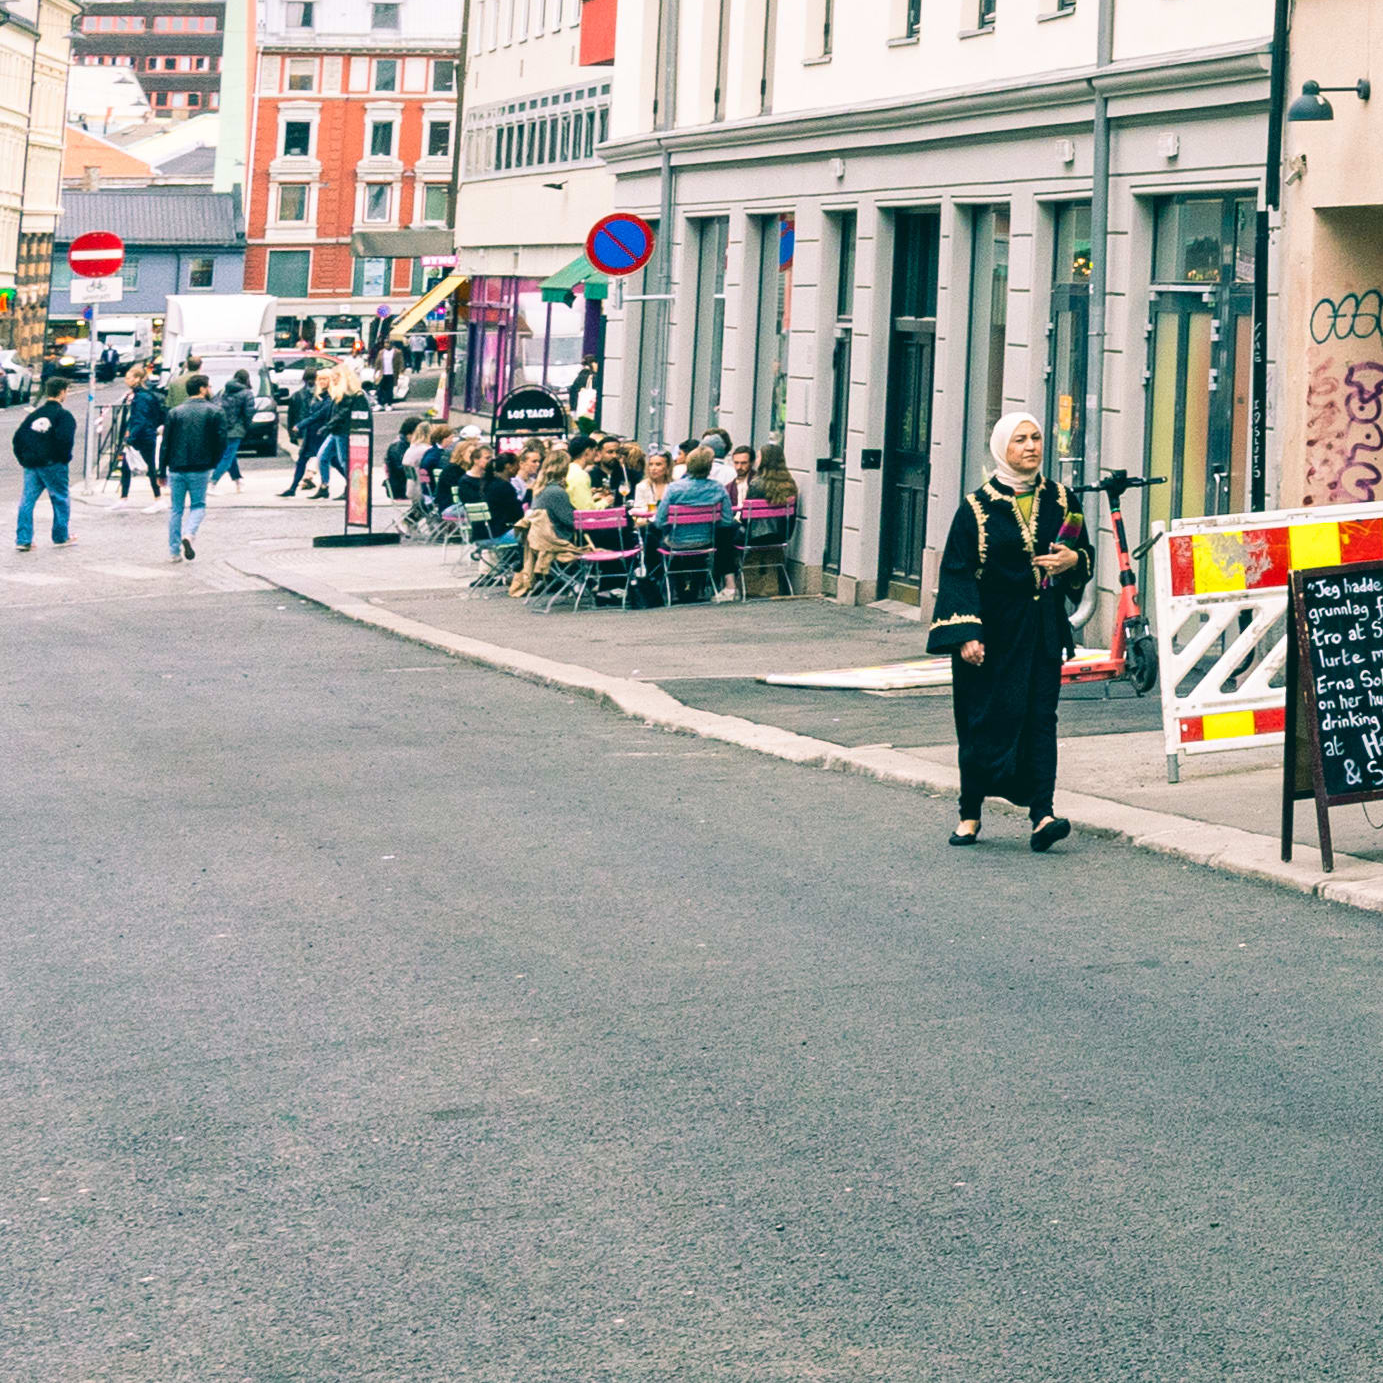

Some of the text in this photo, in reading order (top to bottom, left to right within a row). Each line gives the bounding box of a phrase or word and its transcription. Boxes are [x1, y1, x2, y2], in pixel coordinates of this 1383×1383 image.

[507, 407, 555, 420] LOS TACOS
[1343, 577, 1383, 594] hadde
[1308, 599, 1369, 625] grunnlag
[1311, 627, 1342, 646] tro
[1348, 622, 1366, 641] at
[1319, 648, 1365, 668] lurte
[1317, 675, 1355, 694] Erna
[1318, 699, 1335, 710] on
[1339, 694, 1363, 709] her
[1322, 710, 1380, 733] drinking
[1324, 735, 1345, 756] at
[1343, 758, 1362, 785] &
